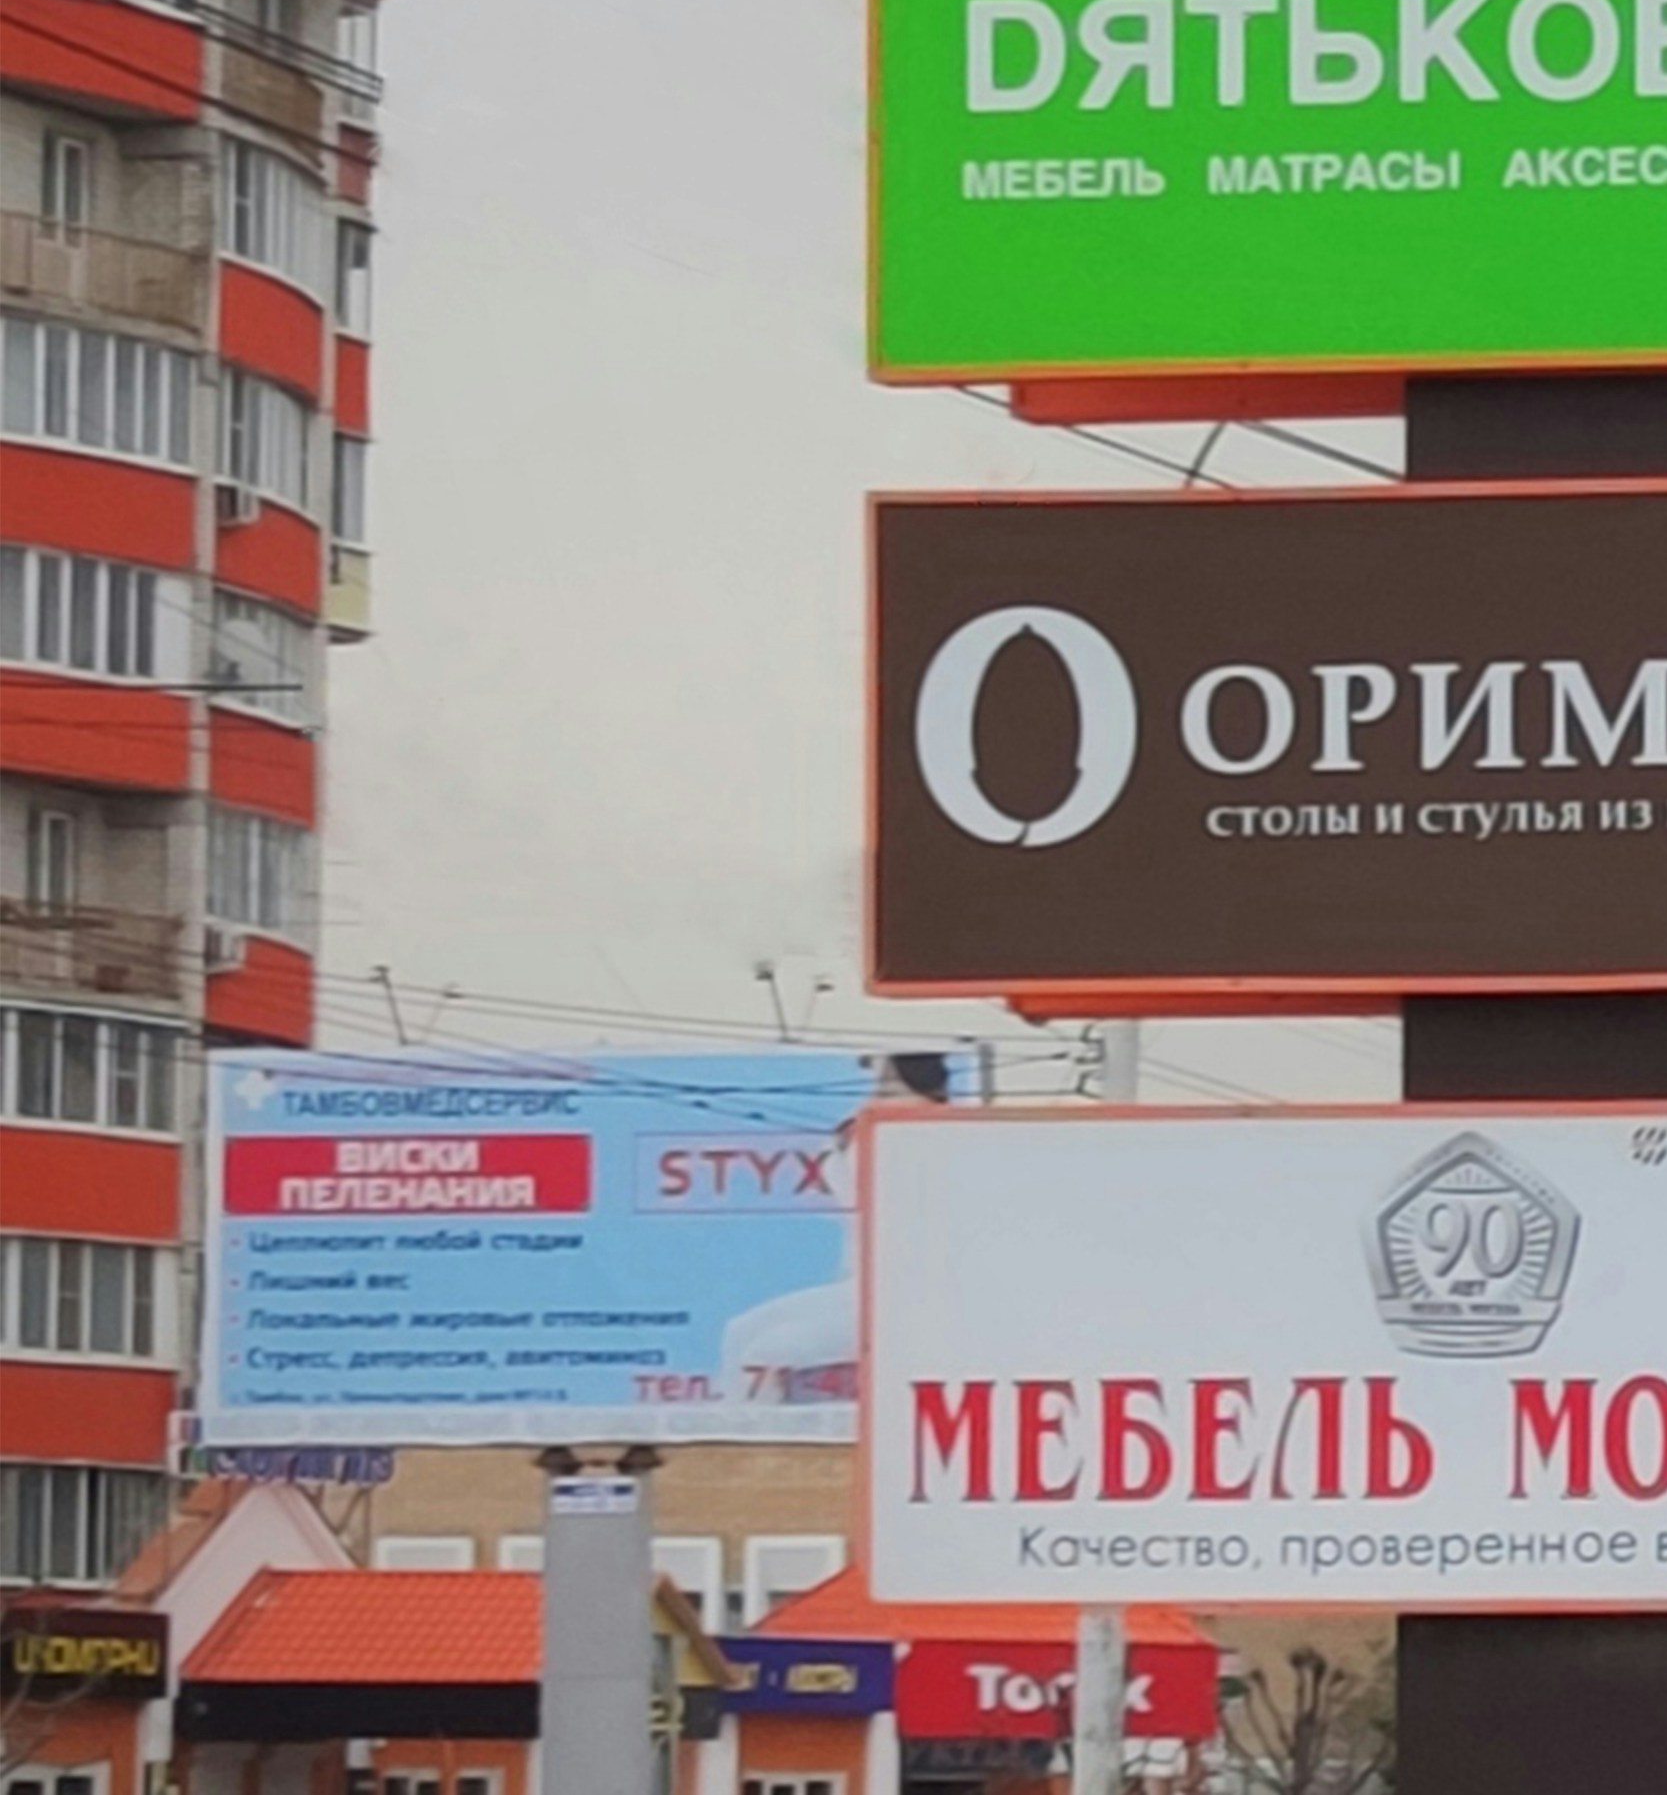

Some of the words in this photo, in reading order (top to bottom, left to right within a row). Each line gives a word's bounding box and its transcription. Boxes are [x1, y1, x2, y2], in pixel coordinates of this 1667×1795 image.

[960, 157, 1167, 201] МЕБЕЛЬ
[1206, 149, 1462, 196] МАТРАСЫ
[1206, 804, 1361, 837] СТОЛЫ
[1376, 804, 1404, 833] И
[1416, 801, 1585, 842] СТУЛЬЯ
[1599, 799, 1654, 831] ИЗ
[282, 1089, 582, 1117] ТАМБОВМЕДСЕРВИС
[336, 1140, 480, 1173] ВИСКИ
[658, 1149, 834, 1196] STYX
[279, 1175, 536, 1210] ПЕЛЕНАНИЯ
[1419, 1202, 1525, 1279] 90
[908, 1375, 1436, 1504] МЕБЕЛЬ
[1018, 1525, 1263, 1573] Качество,
[1281, 1528, 1638, 1575] проверенное
[964, 1663, 1154, 1713] Torx
